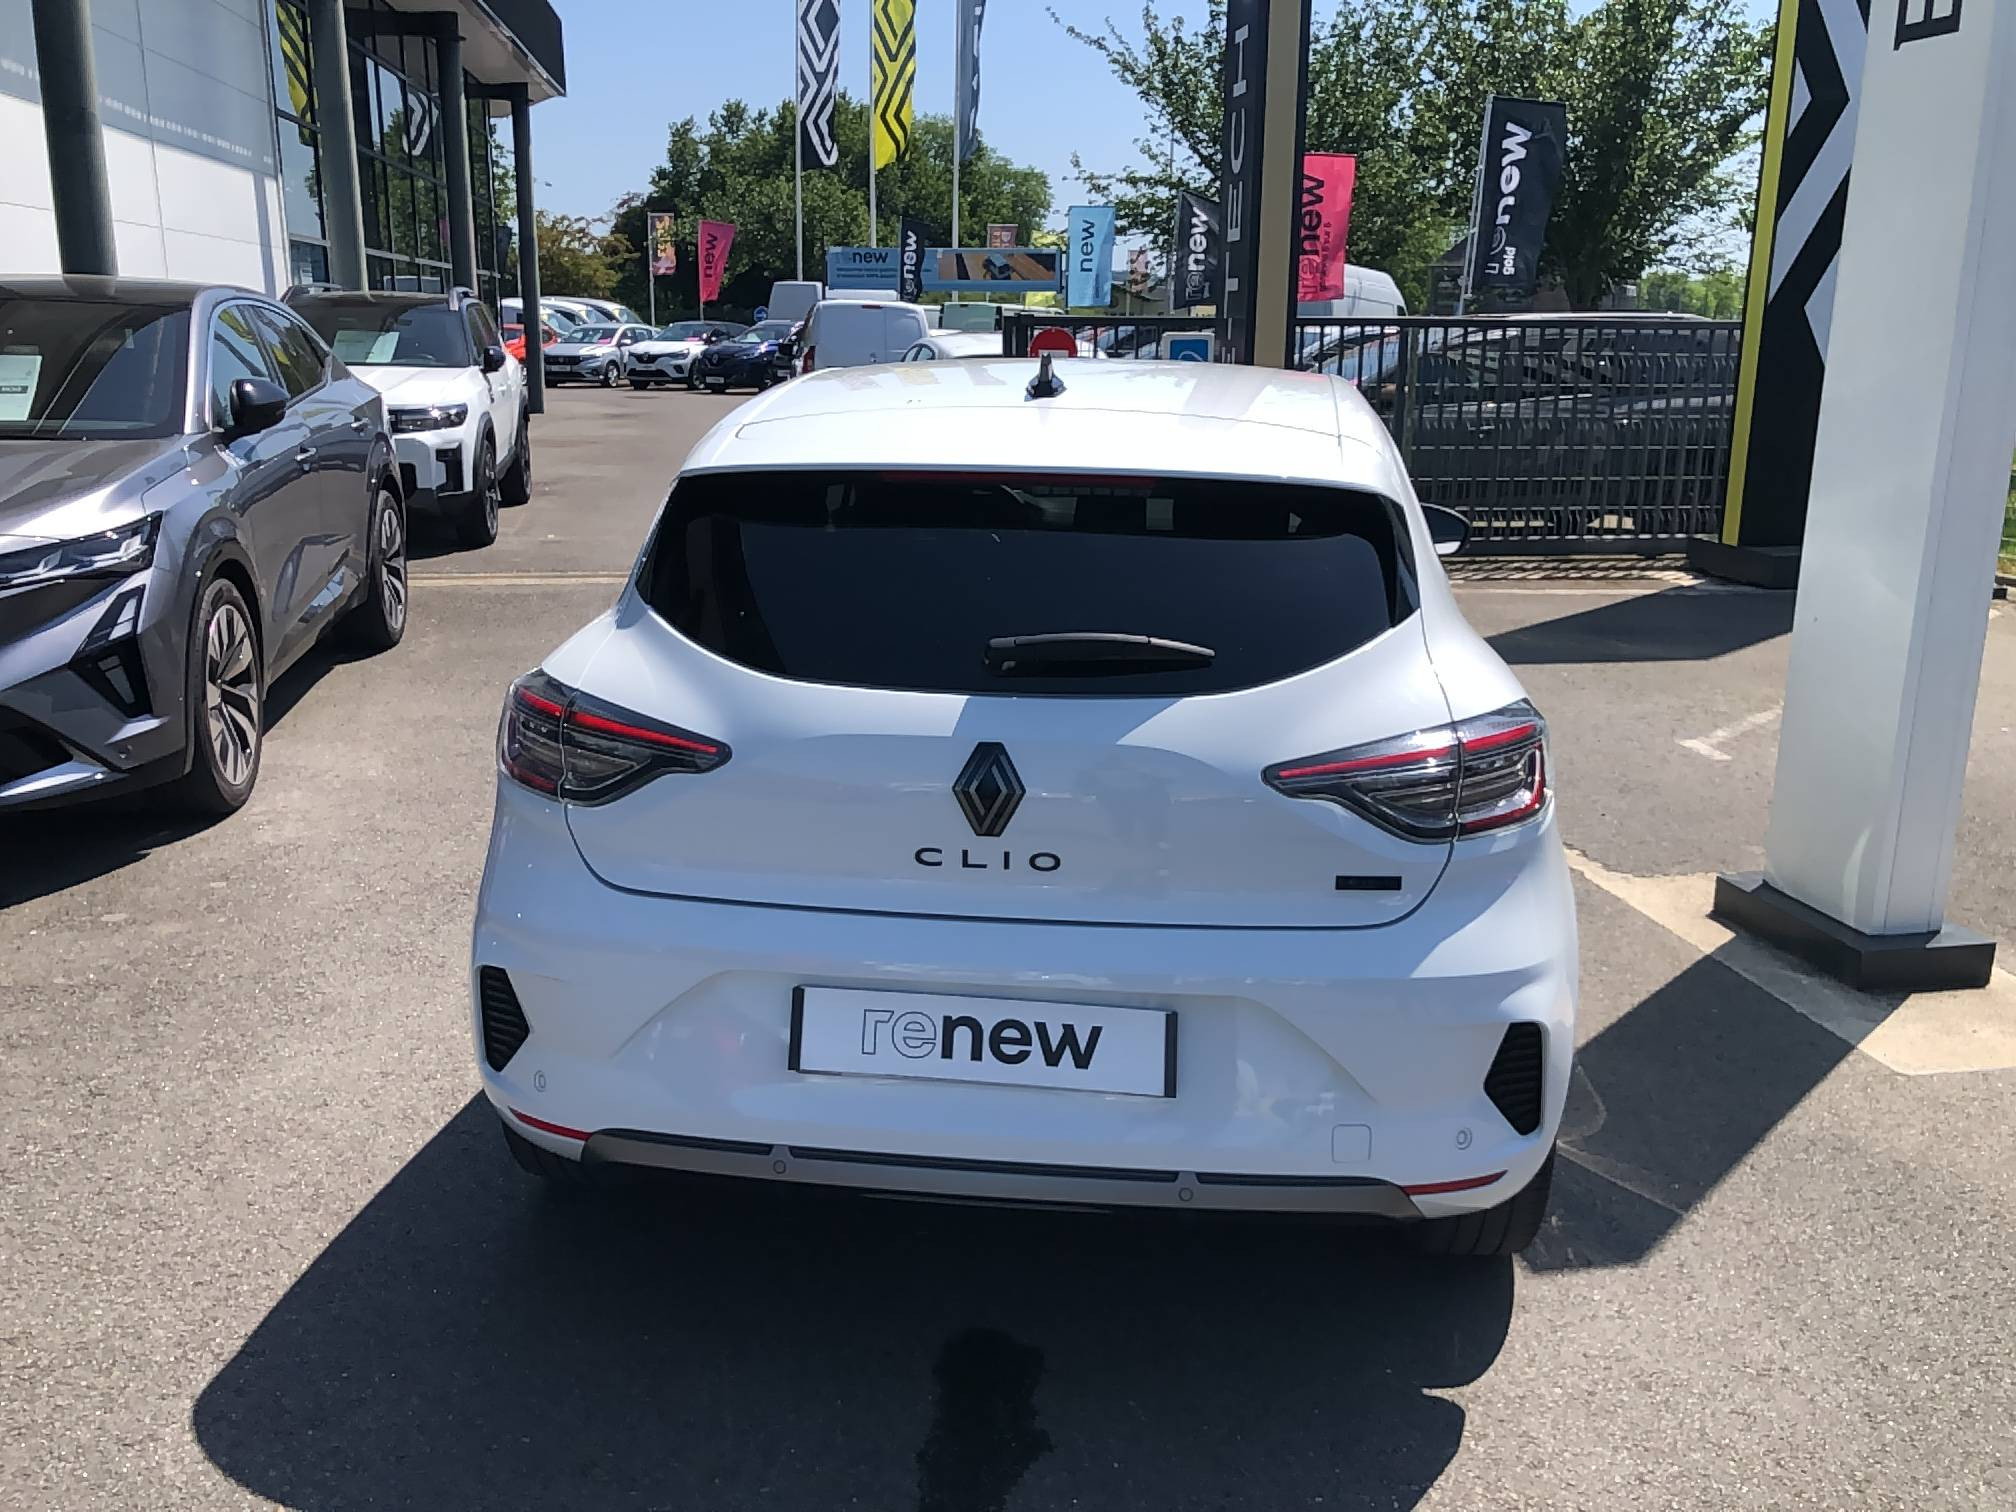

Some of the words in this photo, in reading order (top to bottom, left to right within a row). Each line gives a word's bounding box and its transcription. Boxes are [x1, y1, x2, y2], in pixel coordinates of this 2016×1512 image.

[1222, 24, 1249, 363] -TECH
[914, 847, 1061, 872] CLIO
[861, 1008, 1103, 1070] renew
